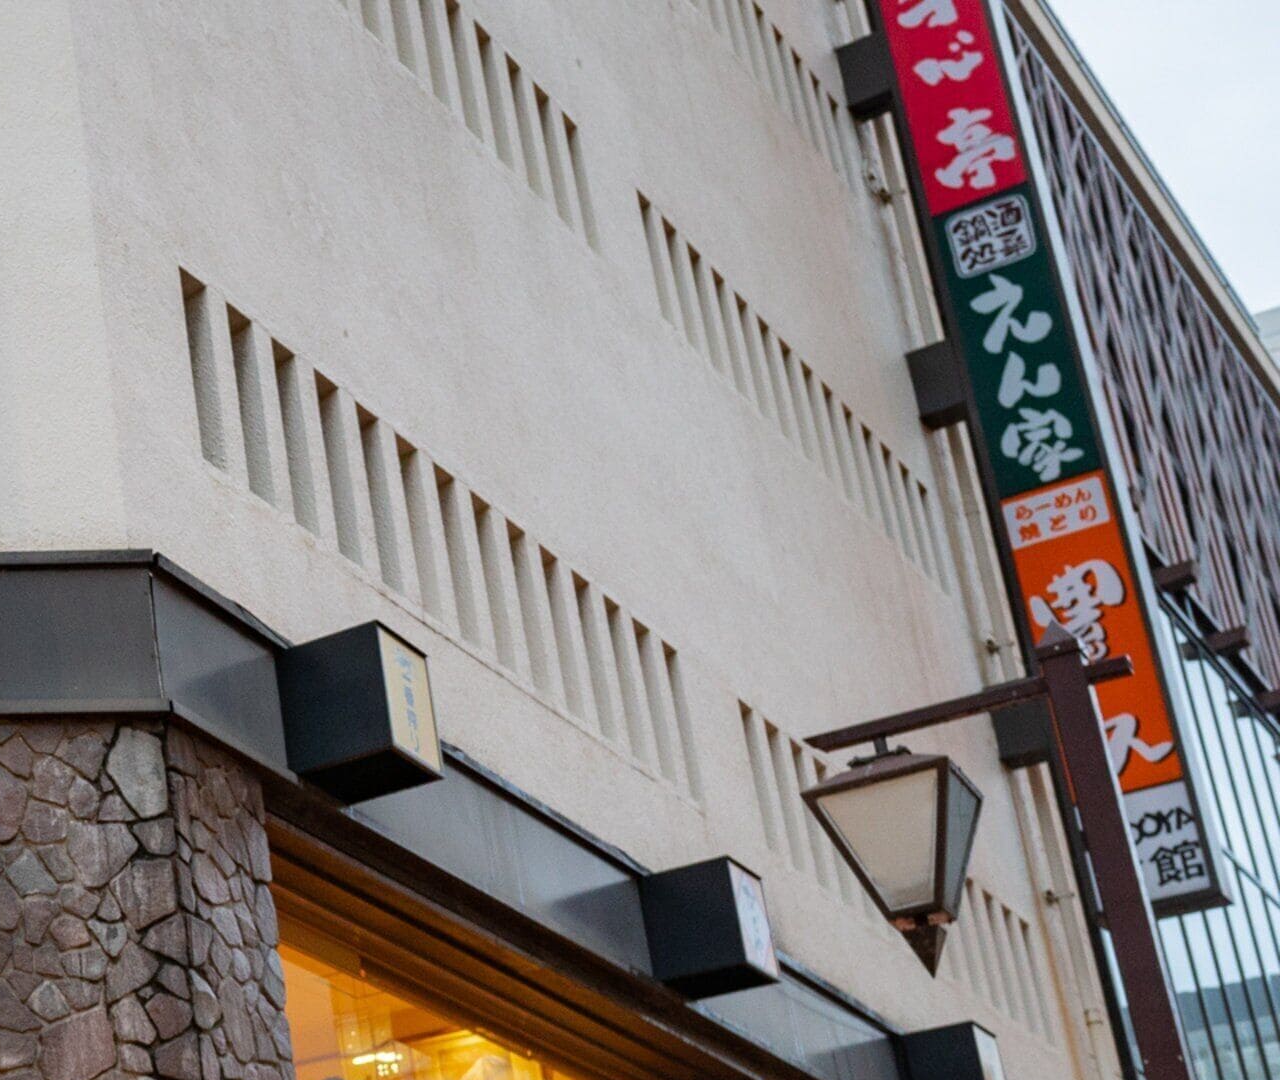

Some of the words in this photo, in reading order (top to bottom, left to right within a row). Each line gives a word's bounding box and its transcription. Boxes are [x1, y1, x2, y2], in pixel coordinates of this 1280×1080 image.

[969, 273, 1085, 483] えん家
[1014, 487, 1092, 522] らーめん
[1018, 502, 1098, 542] 焼とり
